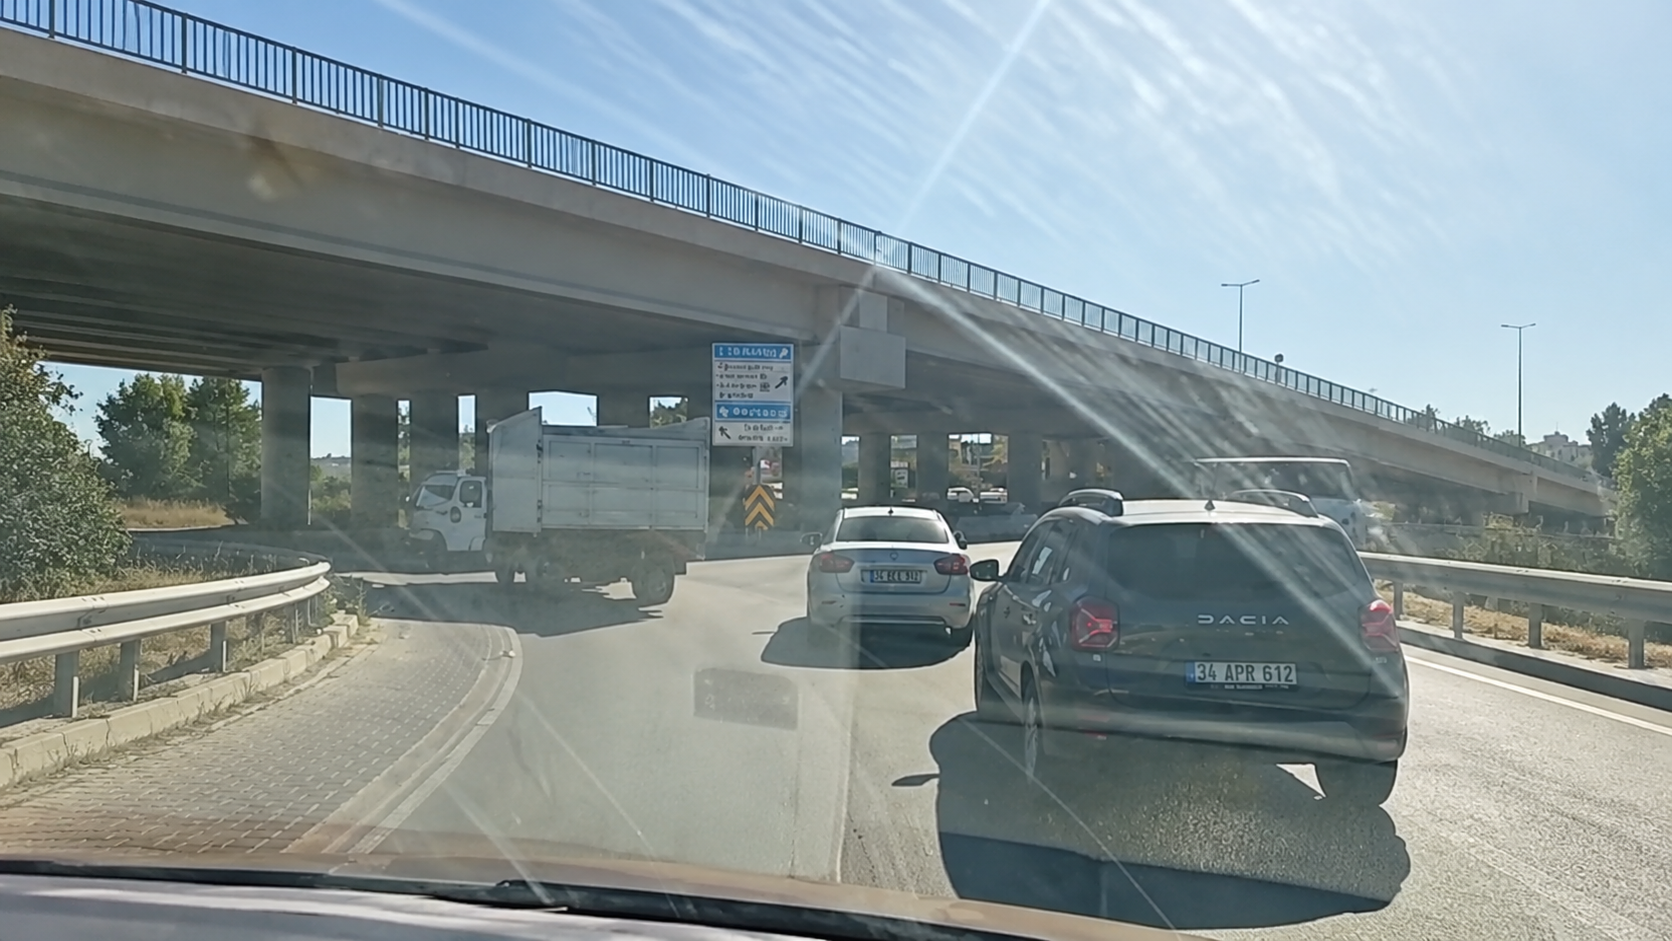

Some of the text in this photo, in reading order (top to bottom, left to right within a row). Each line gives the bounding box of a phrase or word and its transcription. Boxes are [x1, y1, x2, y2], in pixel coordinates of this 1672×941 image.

[1198, 614, 1290, 626] DACIA
[1197, 663, 1294, 683] 34 APR 612
